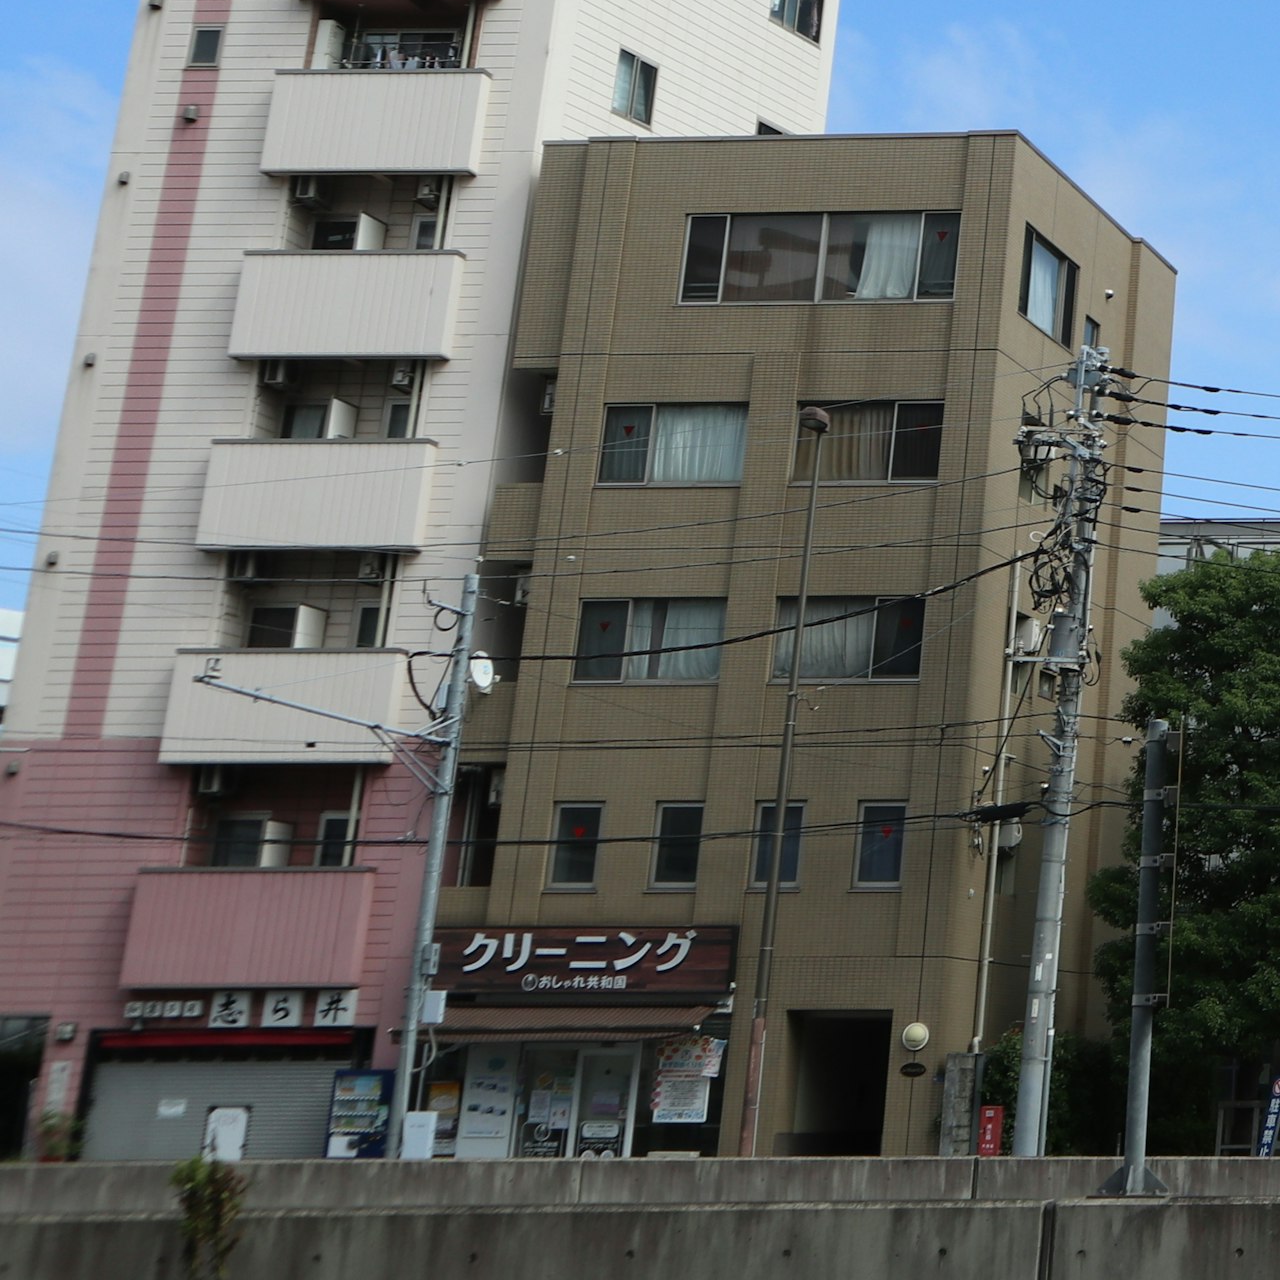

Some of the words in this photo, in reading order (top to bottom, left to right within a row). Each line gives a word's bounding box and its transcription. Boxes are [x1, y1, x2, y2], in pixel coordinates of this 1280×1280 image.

[462, 929, 697, 974] クリーニング
[539, 975, 627, 991] おしゃれ共和国
[211, 992, 349, 1024] 志ら井
[1259, 1098, 1280, 1157] 駐車禁止
